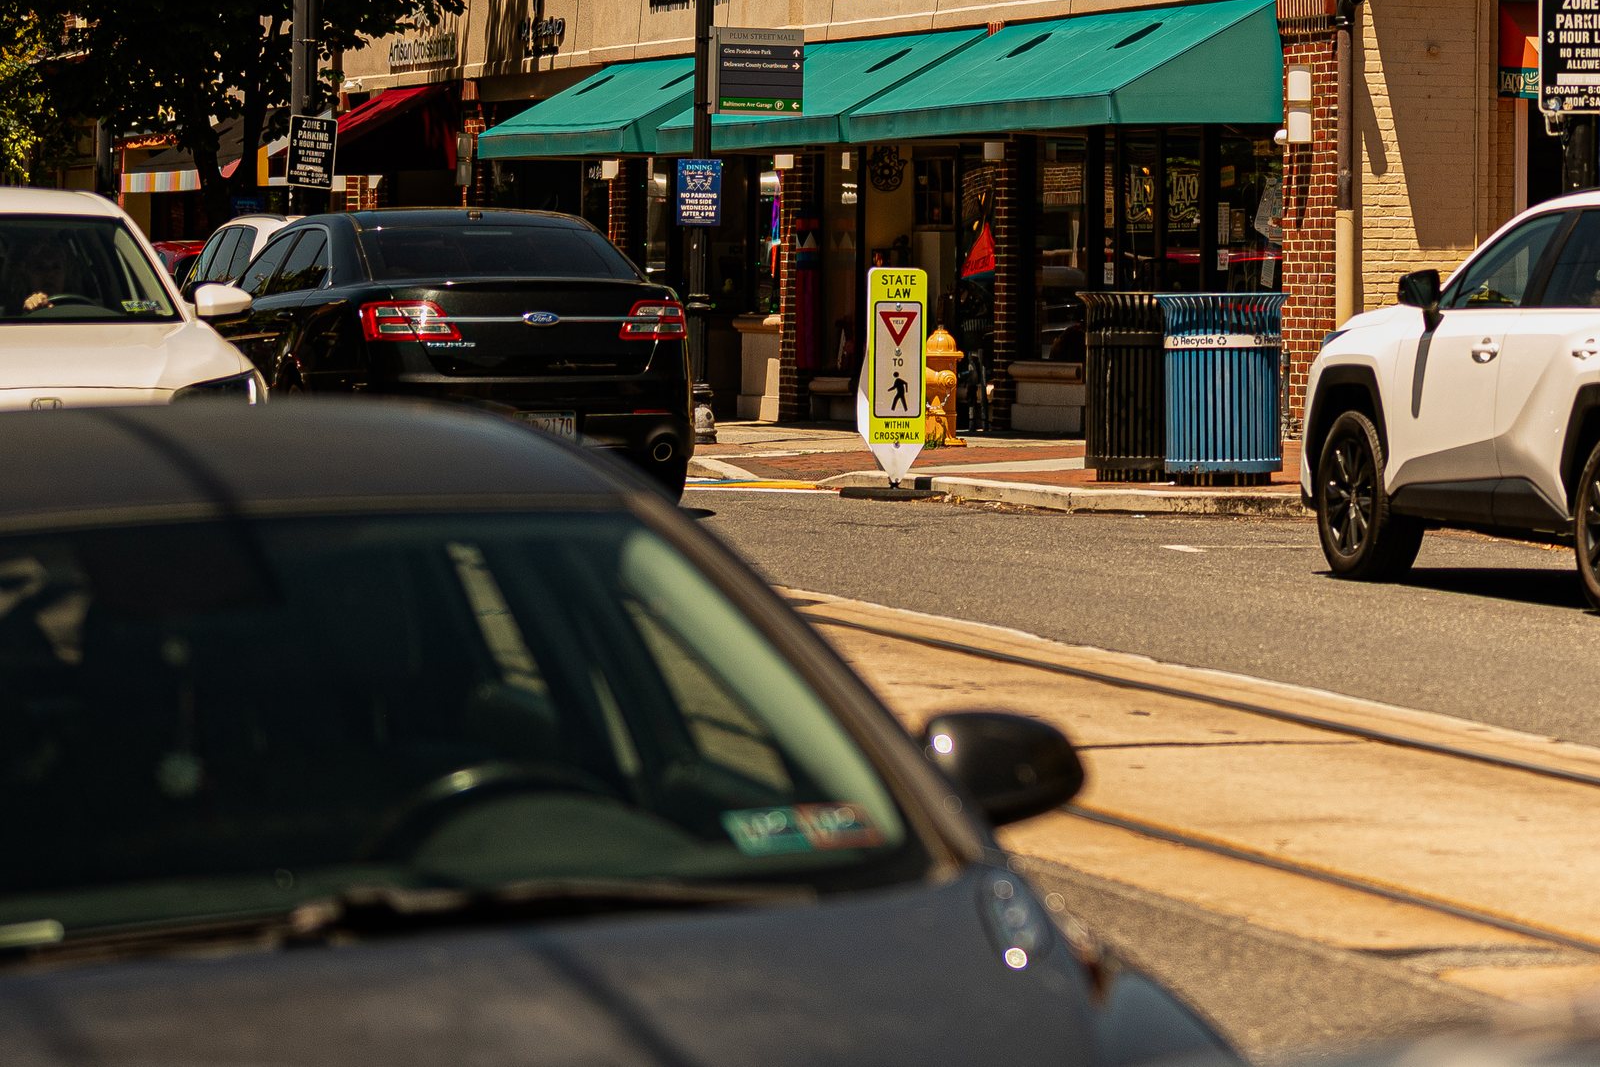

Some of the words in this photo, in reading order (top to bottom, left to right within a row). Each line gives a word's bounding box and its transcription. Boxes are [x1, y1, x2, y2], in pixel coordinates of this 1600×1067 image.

[730, 32, 748, 40] PLUM
[1548, 31, 1555, 44] 3
[1560, 32, 1590, 44] HOUR
[388, 38, 412, 62] Artisan
[1560, 48, 1572, 58] NO
[1546, 86, 1578, 94] 8:00AM
[302, 120, 320, 130] ZONE
[298, 130, 329, 142] PARKING
[298, 140, 314, 148] HOUR
[316, 142, 332, 150] LIMIT
[306, 150, 325, 158] PERMITS
[301, 156, 322, 164] ALLOWED
[1169, 172, 1198, 206] JACO
[882, 275, 916, 286] STATE
[887, 288, 910, 298] LAW
[532, 314, 553, 323] Ford
[1180, 336, 1214, 346] Recycle
[892, 358, 904, 366] TO
[874, 432, 920, 440] CROSSWALK
